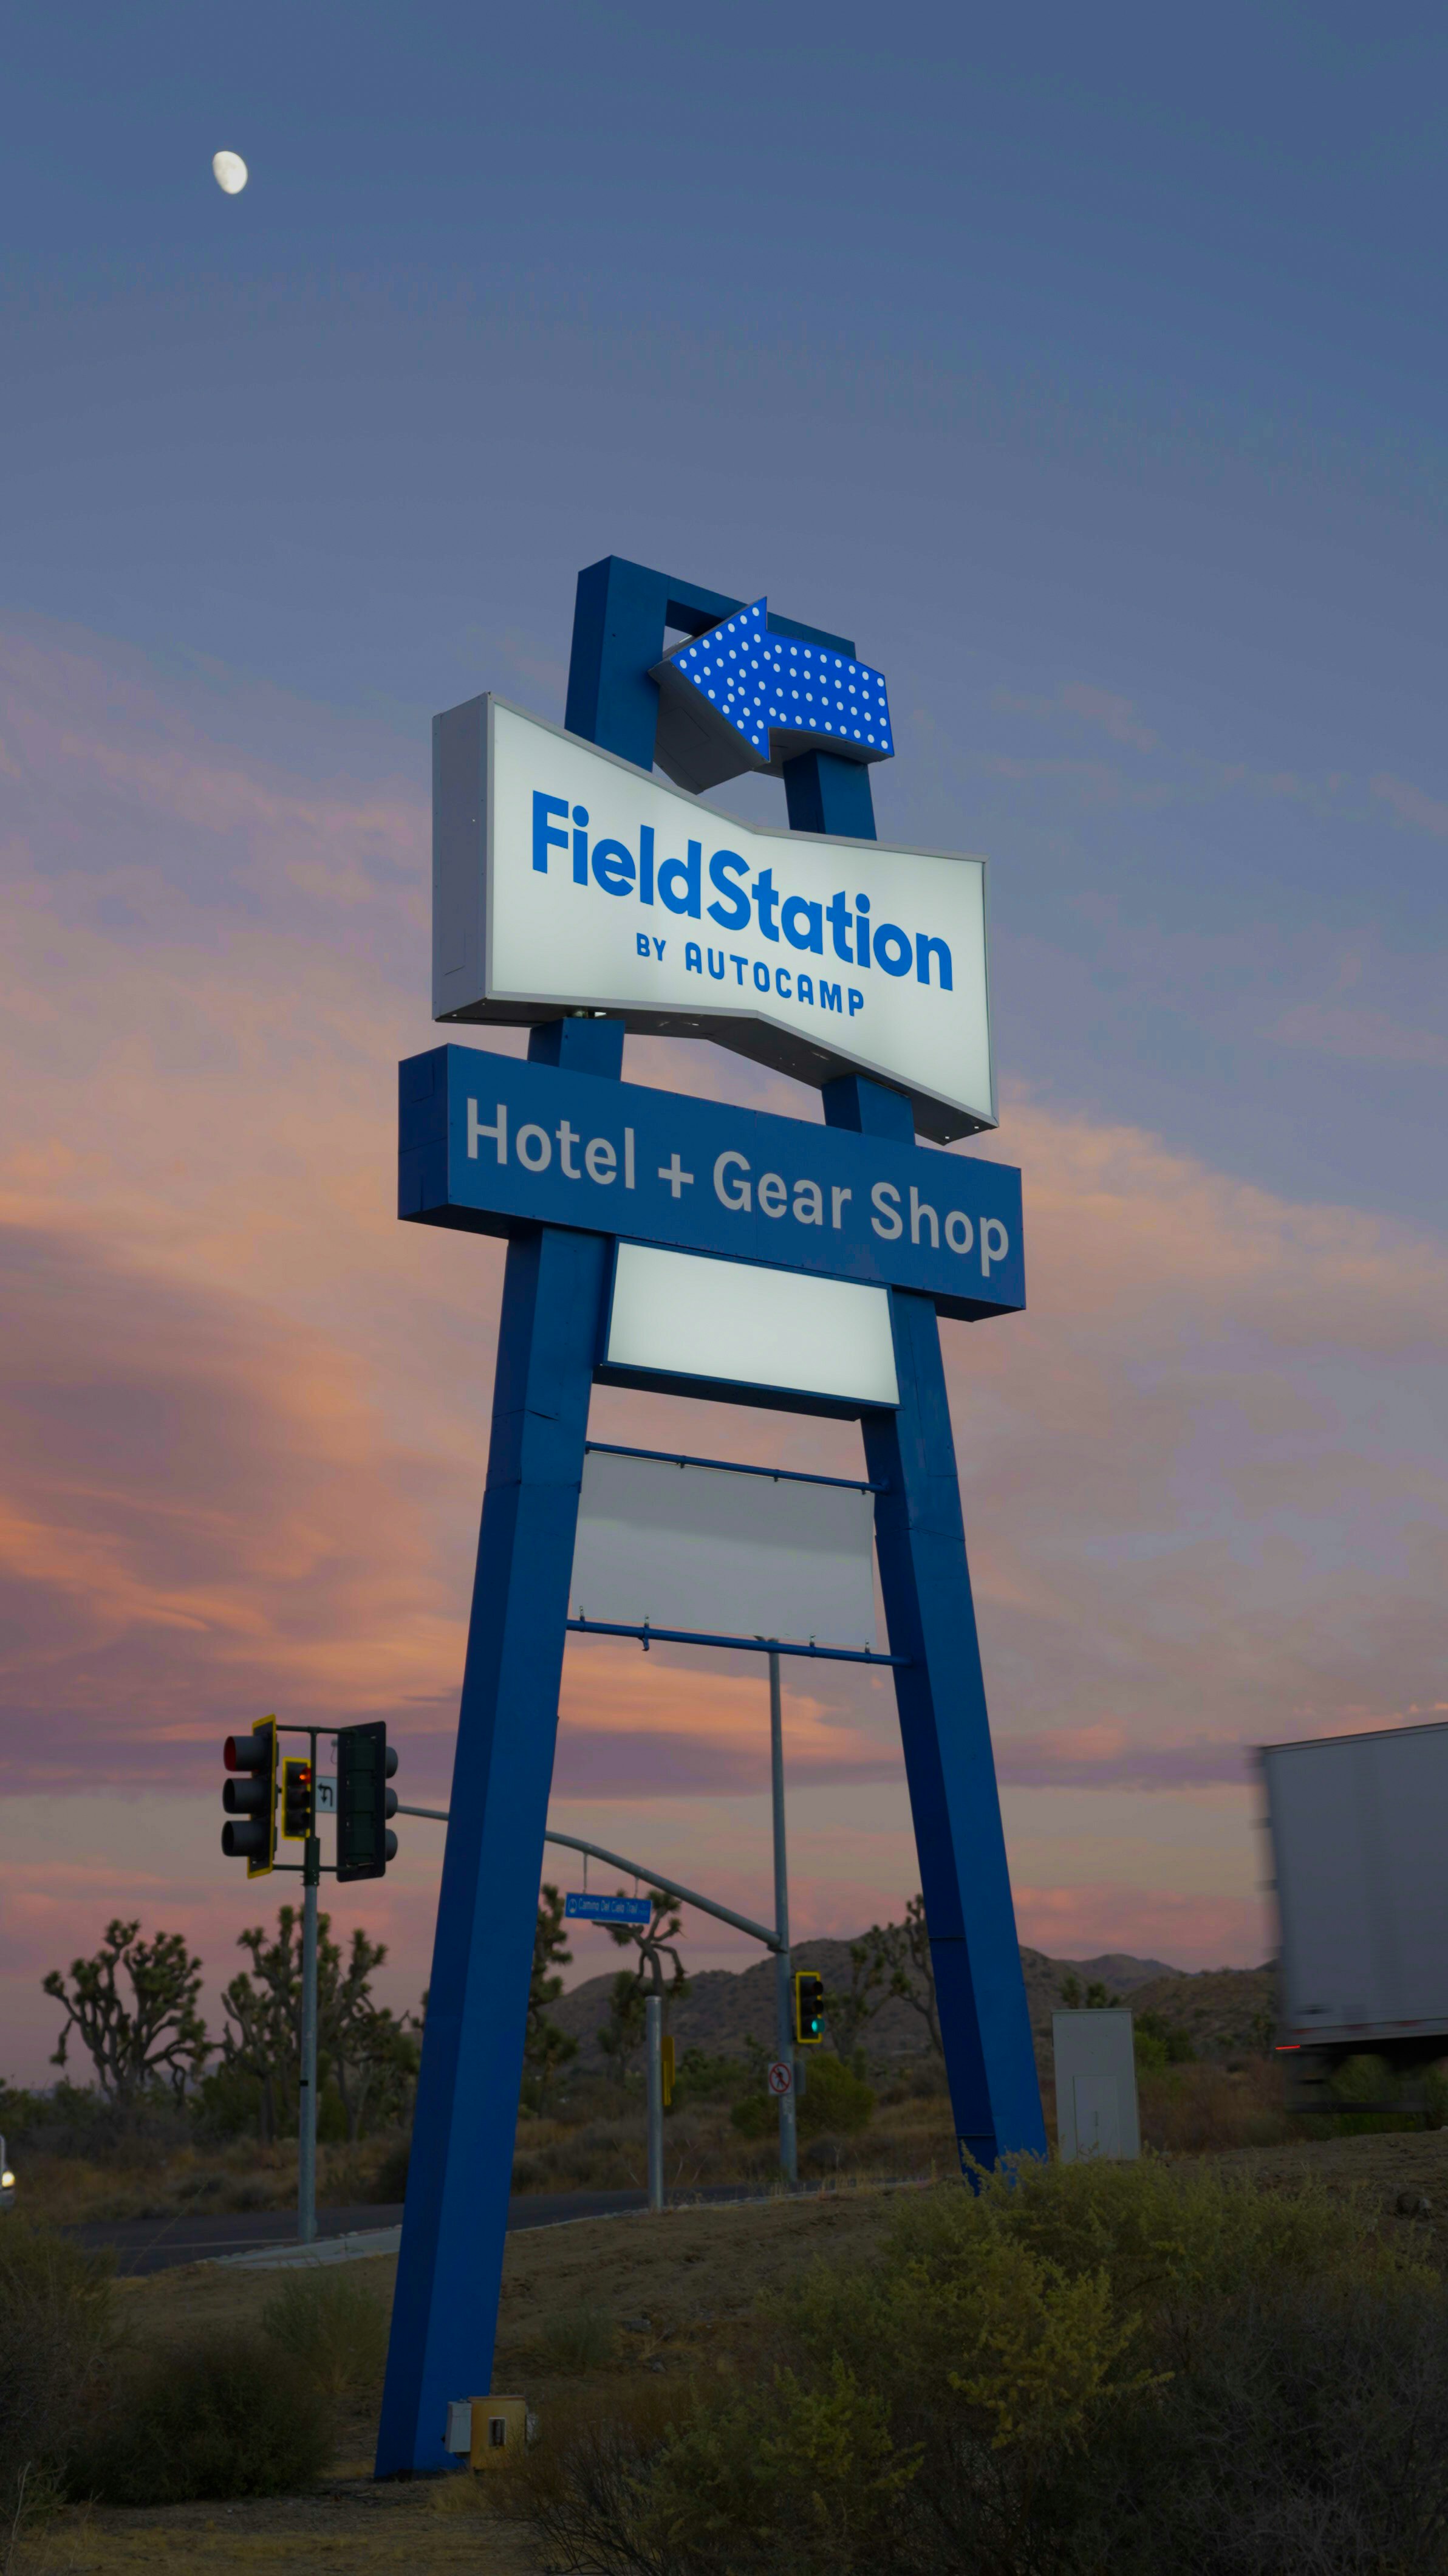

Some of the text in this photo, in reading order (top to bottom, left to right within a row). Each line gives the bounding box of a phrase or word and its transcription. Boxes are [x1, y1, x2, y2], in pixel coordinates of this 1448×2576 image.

[532, 790, 953, 991] FieldStation
[636, 933, 864, 1016] BY AUTOCAMP
[466, 1097, 1009, 1277] Hotel + Gear Shop
